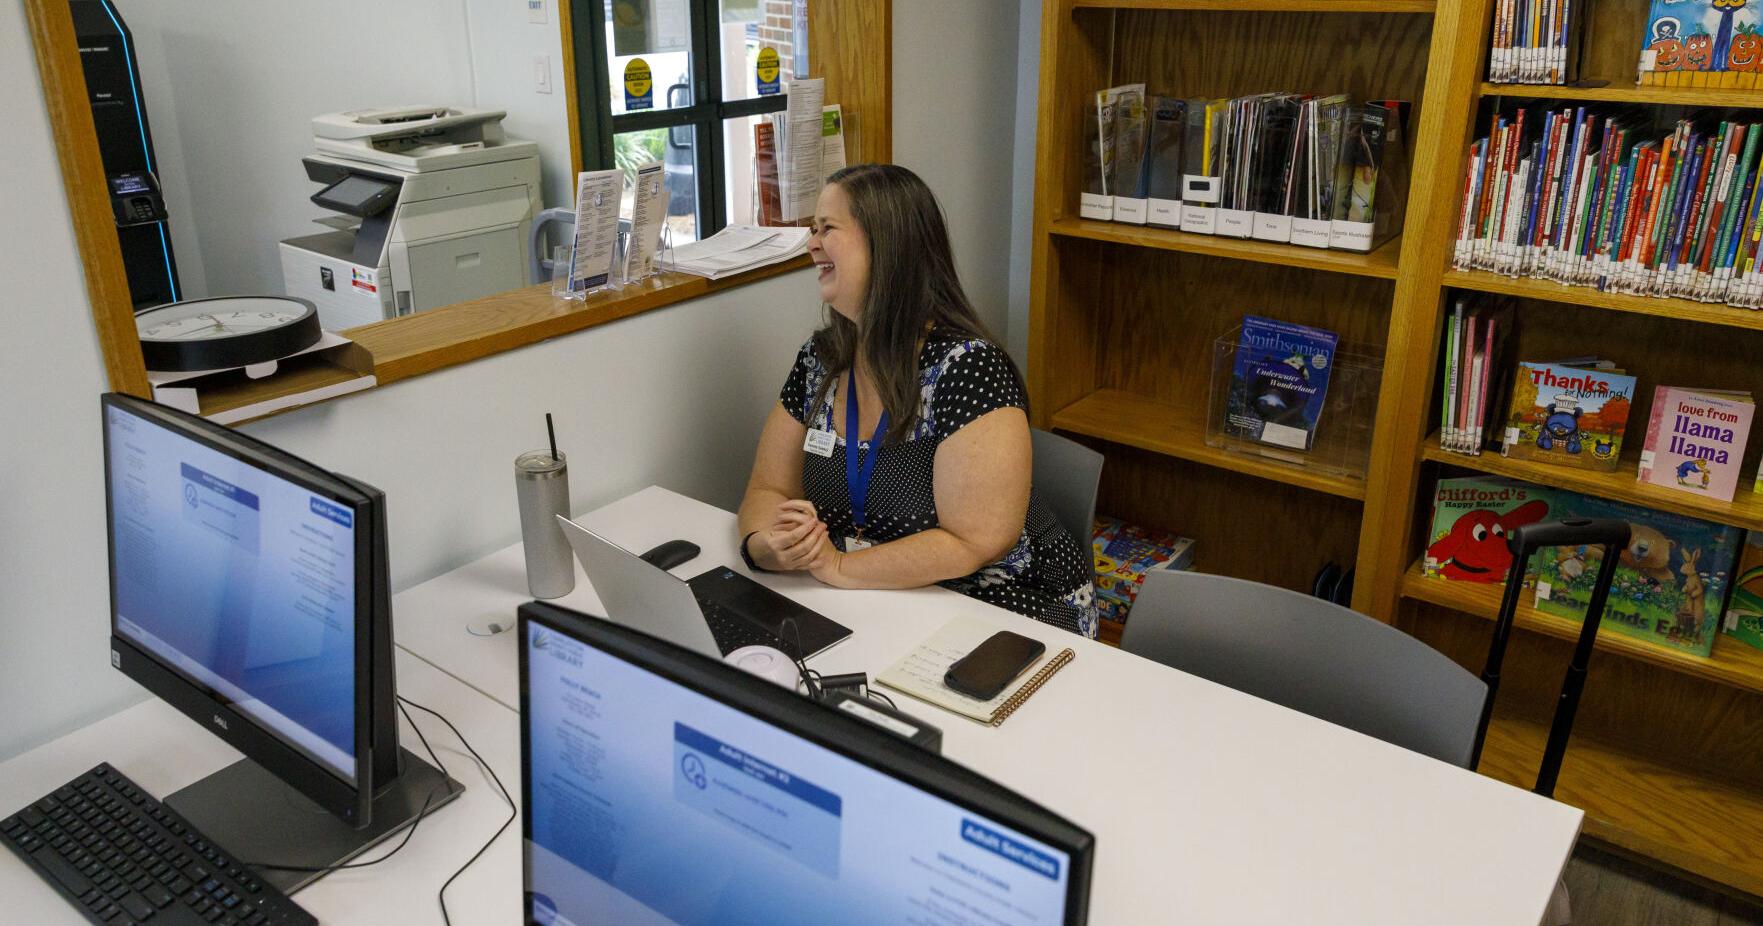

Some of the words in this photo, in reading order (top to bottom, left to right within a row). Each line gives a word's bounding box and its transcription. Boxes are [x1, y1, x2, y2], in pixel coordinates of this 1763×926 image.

[1243, 327, 1330, 359] Smithsonian
[1256, 367, 1300, 383] Underwater
[1532, 368, 1610, 394] Thanks
[1270, 379, 1316, 395] Wonderland
[1576, 386, 1629, 401] Nothing!
[1678, 401, 1705, 417] love
[1706, 407, 1738, 424] from
[1673, 415, 1734, 444] llama
[1669, 435, 1729, 465] llama
[1437, 488, 1527, 502] Clifford's
[1445, 501, 1473, 509] Happy
[1476, 501, 1507, 509] Easter
[966, 825, 1000, 851] Adult
[1000, 839, 1057, 874] Services
